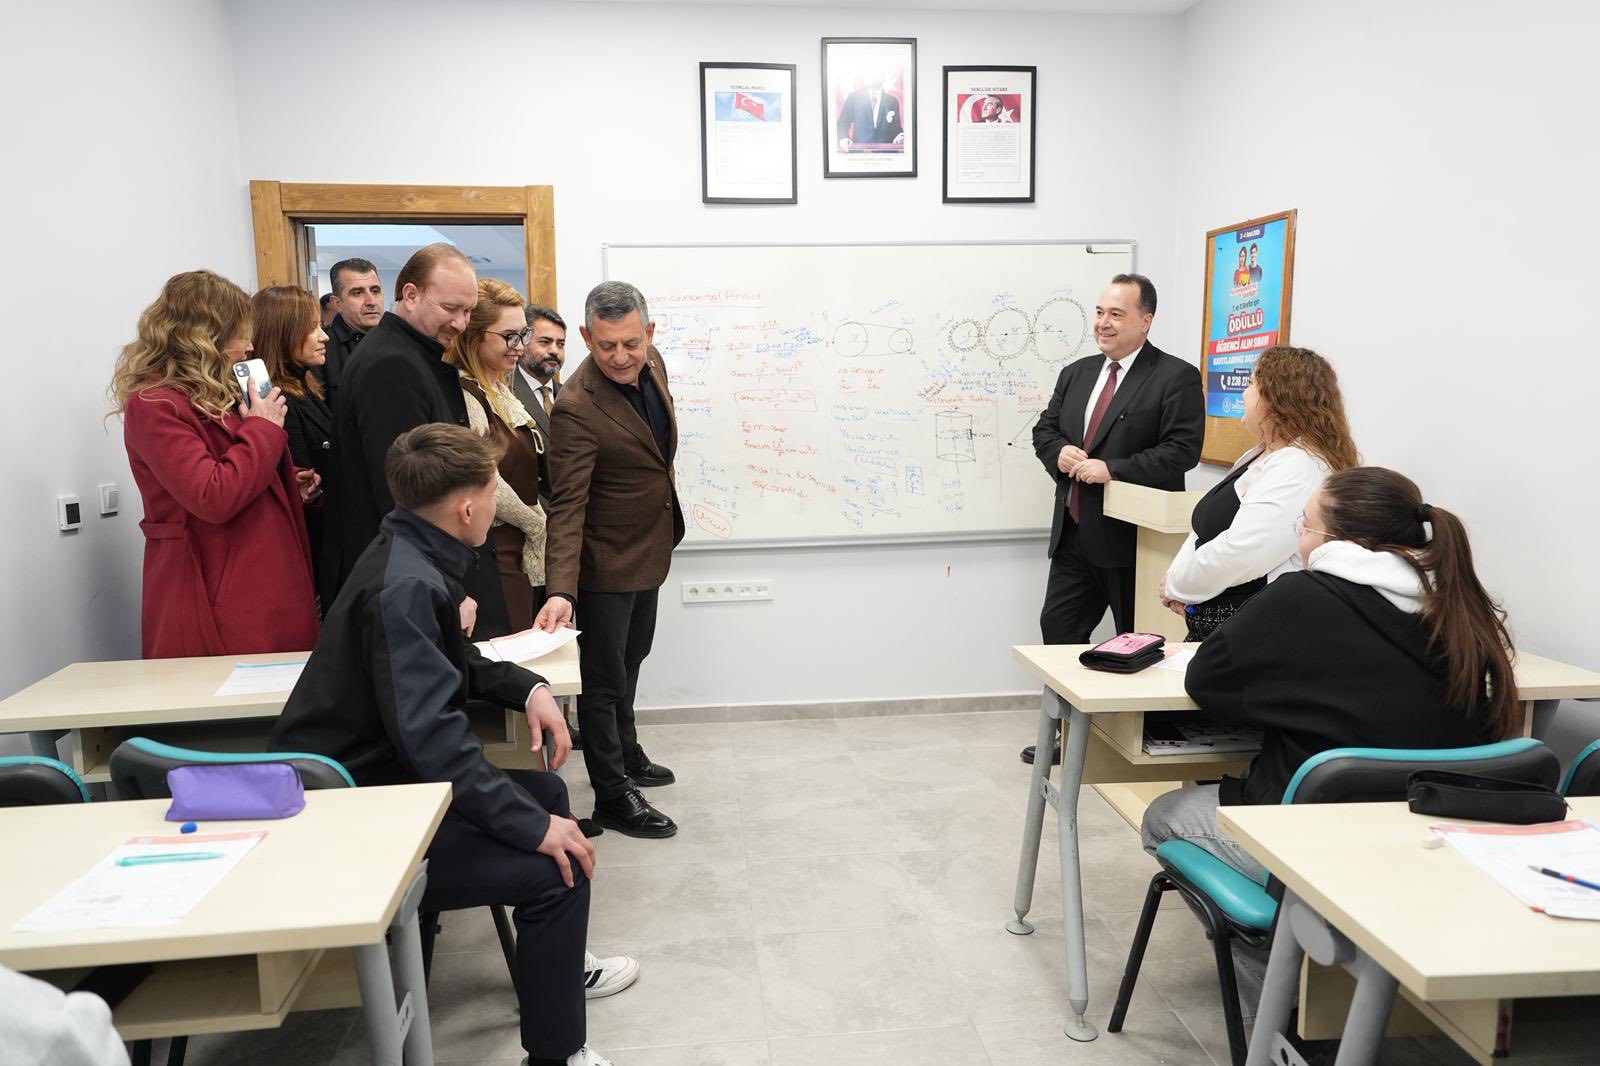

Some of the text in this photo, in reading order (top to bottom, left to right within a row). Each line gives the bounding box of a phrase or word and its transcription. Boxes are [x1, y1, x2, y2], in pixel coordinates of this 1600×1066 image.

[1229, 310, 1263, 333] ÖDÜLLÜ
[1215, 335, 1270, 353] ÖĞRENCİ ALIM SINAVI
